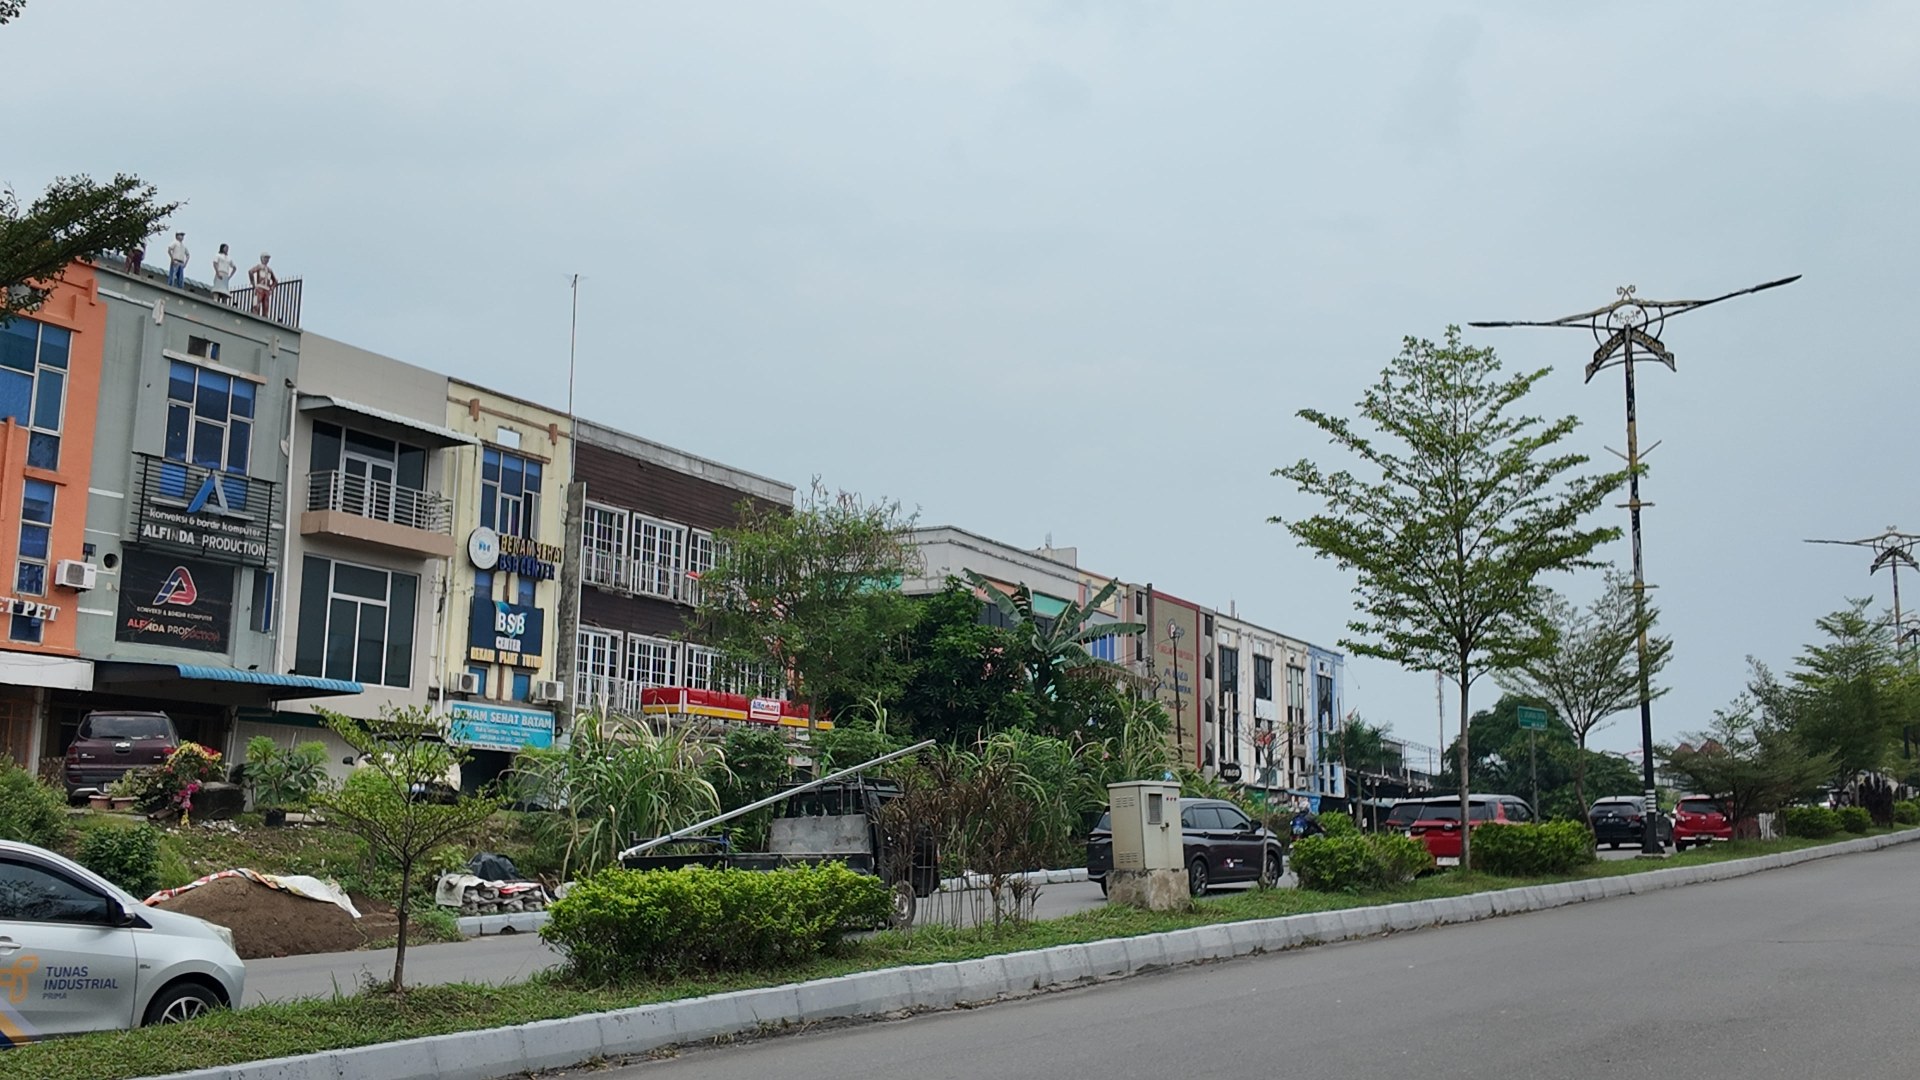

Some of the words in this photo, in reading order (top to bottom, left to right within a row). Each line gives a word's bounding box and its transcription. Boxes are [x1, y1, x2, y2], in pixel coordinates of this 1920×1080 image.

[143, 524, 195, 545] ALFINDA
[202, 534, 267, 557] PRODUCTION
[20, 600, 61, 622] PET
[495, 612, 526, 635] BSB
[496, 636, 521, 653] CENTER
[490, 711, 520, 725] SEHAT
[521, 715, 552, 729] BATAM
[46, 966, 89, 978] TUNAS
[43, 977, 119, 990] INDUSTRIAL
[42, 992, 67, 1000] PRIMA
